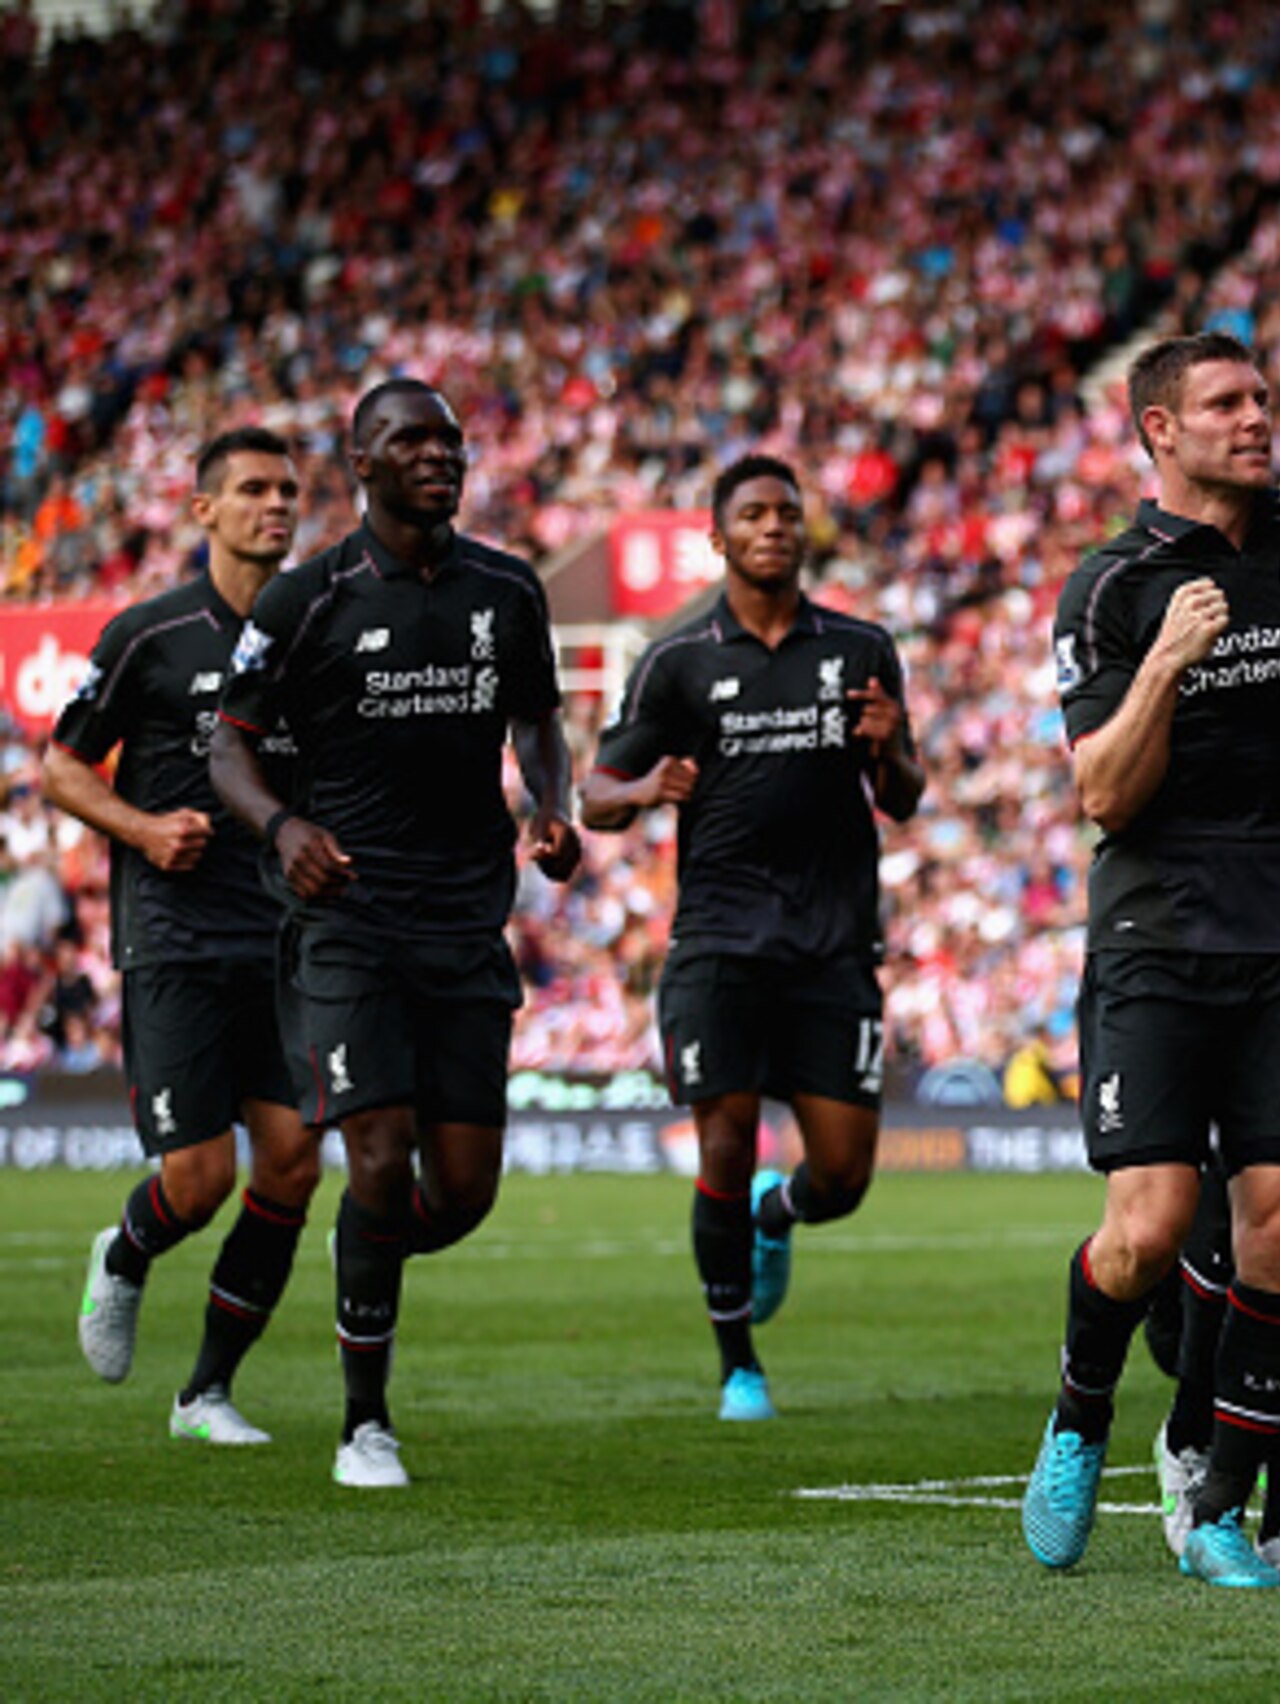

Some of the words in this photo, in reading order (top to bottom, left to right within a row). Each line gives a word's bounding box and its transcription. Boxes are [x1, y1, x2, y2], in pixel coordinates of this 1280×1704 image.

[365, 664, 471, 694] Standard
[357, 691, 469, 718] Chartered
[720, 704, 818, 735] Standard
[719, 730, 818, 757] Chartered
